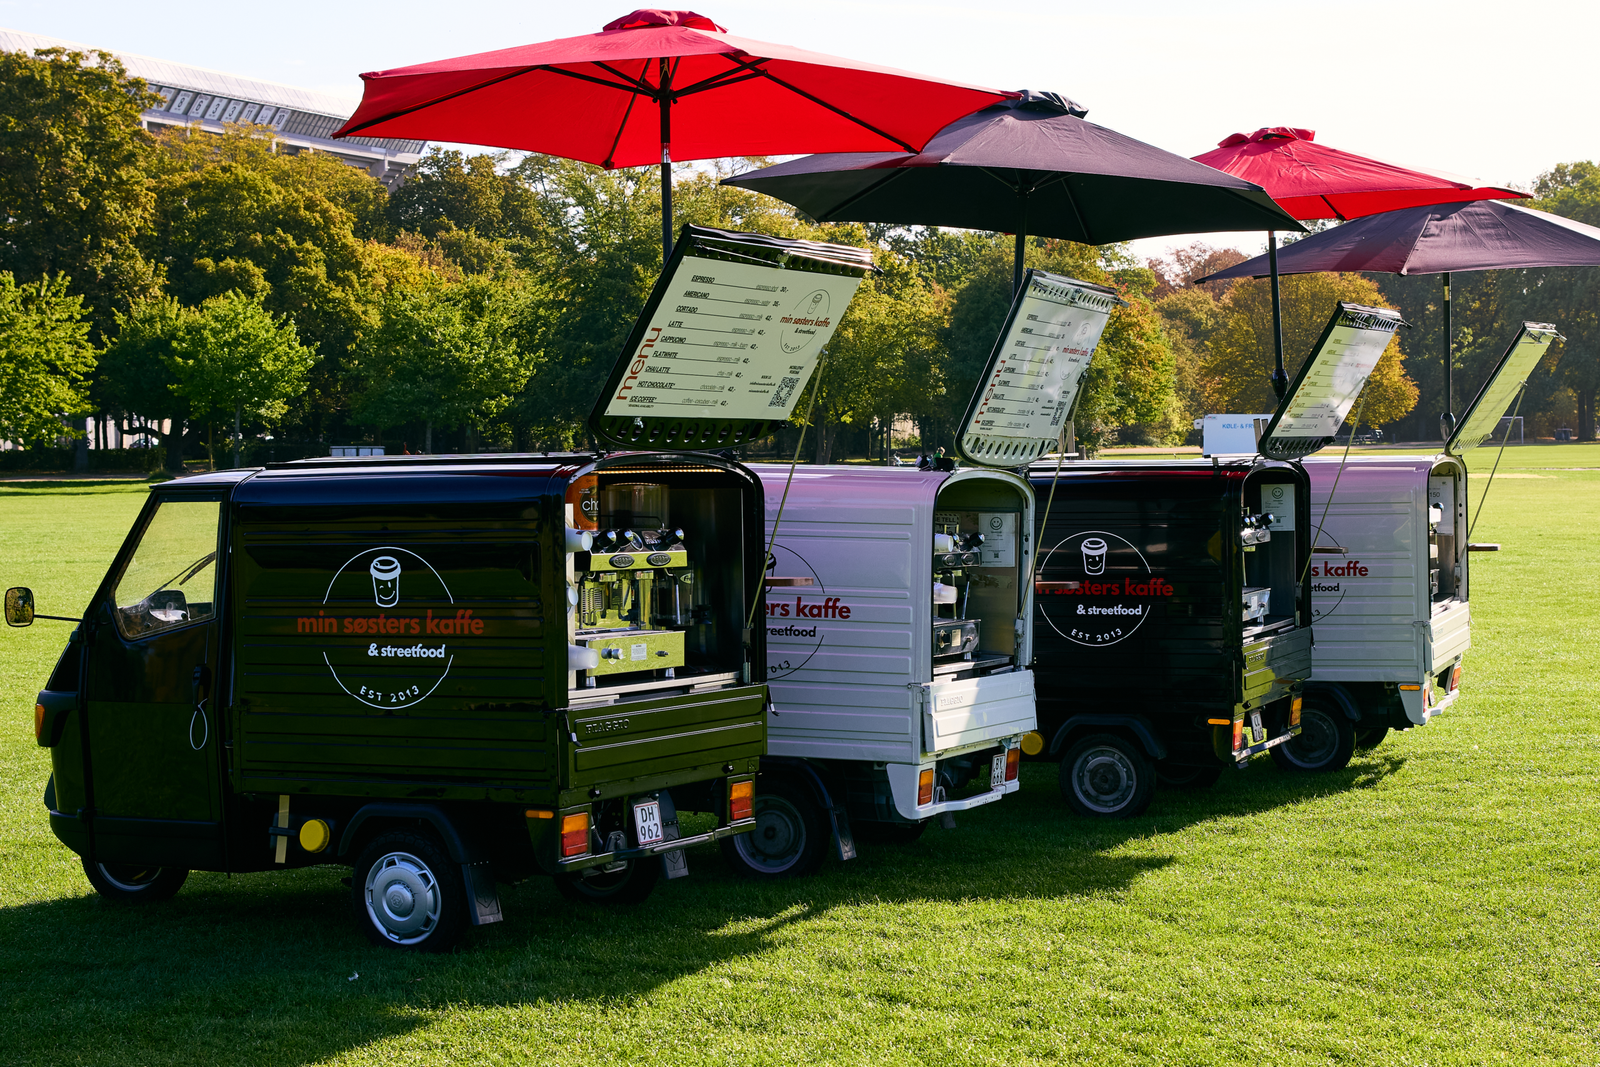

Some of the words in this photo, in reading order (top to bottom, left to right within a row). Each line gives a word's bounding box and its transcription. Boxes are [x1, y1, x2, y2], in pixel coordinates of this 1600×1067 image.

[668, 320, 683, 328] LATTE
[780, 314, 793, 323] min
[814, 317, 830, 327] kaffe
[616, 328, 662, 400] menu
[1324, 560, 1368, 577] kaffe
[1125, 577, 1174, 596] kaffe
[796, 596, 851, 619] kaffe
[1076, 604, 1086, 615] &
[1087, 604, 1142, 615] streetfood
[297, 610, 338, 633] min
[343, 613, 420, 635] søsters
[426, 609, 484, 635] kaffe
[1071, 628, 1090, 641] EST
[1096, 628, 1122, 641] 2013
[368, 643, 379, 656] &
[381, 643, 445, 658] streetfood
[360, 685, 382, 701] EST
[390, 685, 420, 702] 2013
[641, 806, 655, 823] DH
[640, 823, 660, 840] 962
